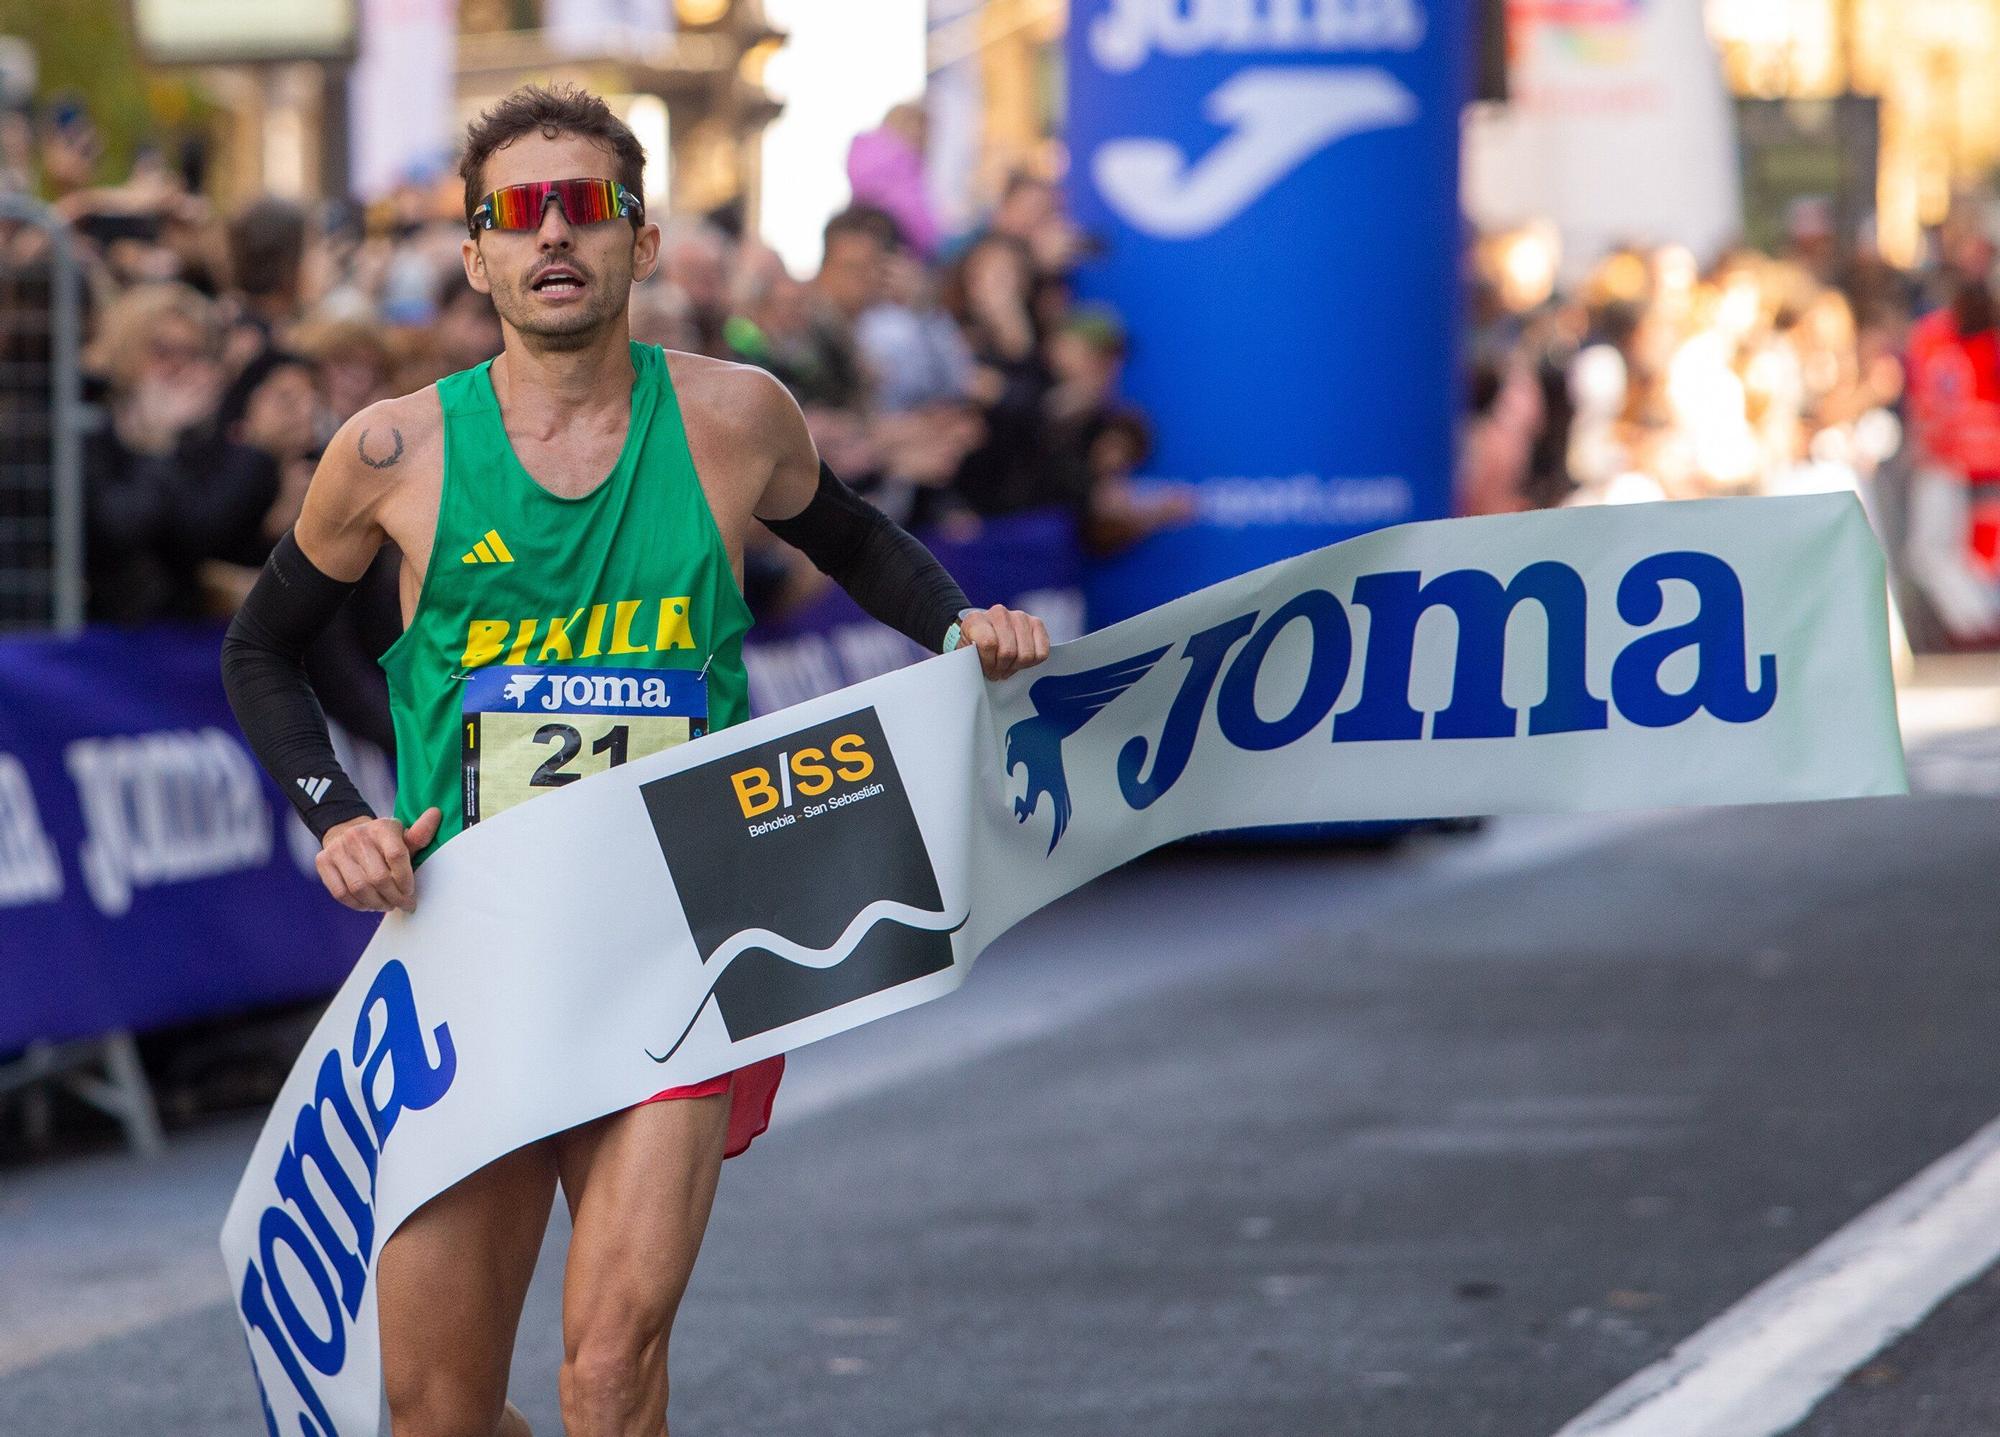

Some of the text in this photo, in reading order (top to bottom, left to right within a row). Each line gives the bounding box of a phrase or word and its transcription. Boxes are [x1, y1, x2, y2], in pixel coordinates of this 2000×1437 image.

[460, 596, 697, 668] BIKILA
[541, 674, 671, 711] Joma
[1116, 550, 1778, 811] Joma
[466, 722, 475, 749] 1
[529, 723, 630, 788] 21
[730, 733, 875, 819] B/SS
[748, 813, 796, 838] Behobia
[803, 802, 828, 818] San
[828, 783, 885, 810] Sebastián
